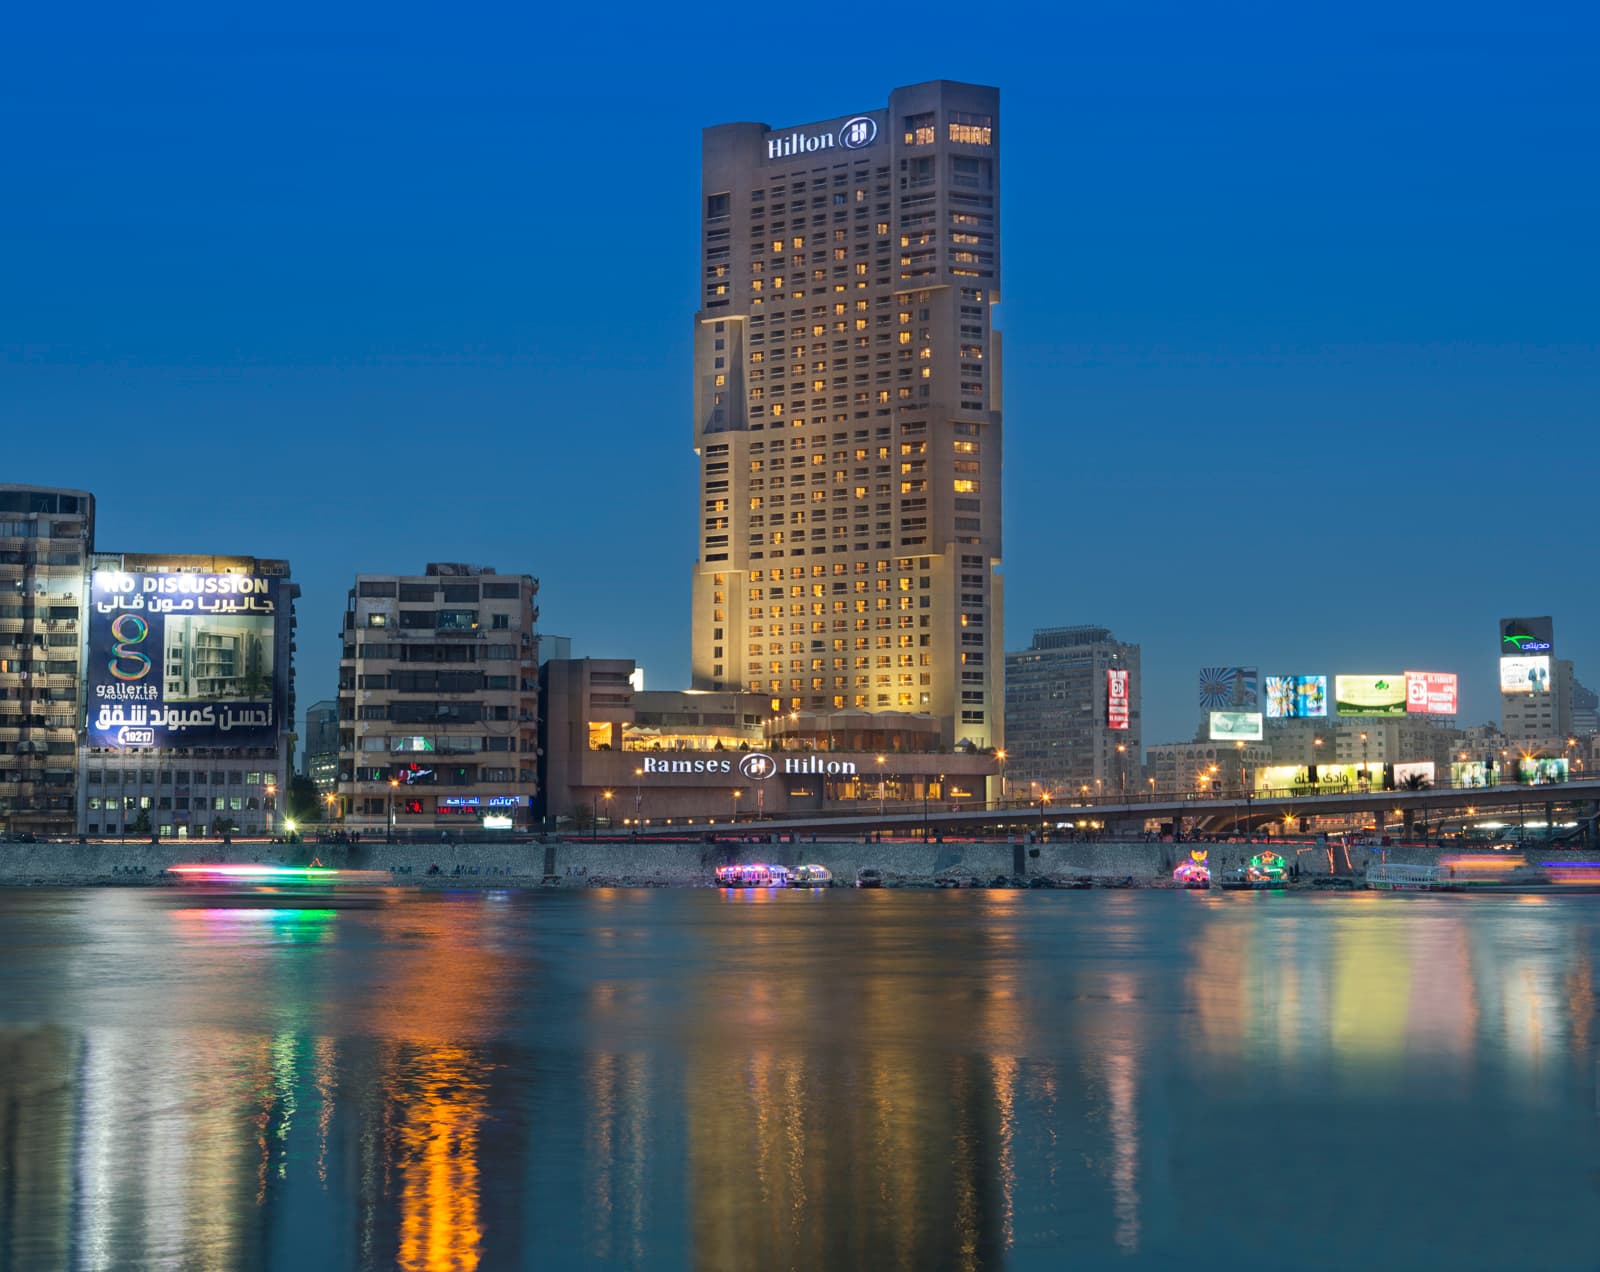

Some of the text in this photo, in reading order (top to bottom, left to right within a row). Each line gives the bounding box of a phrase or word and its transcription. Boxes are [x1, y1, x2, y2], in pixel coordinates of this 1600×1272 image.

[768, 132, 834, 159] Hilton
[103, 577, 269, 594] NO DISCUSSION
[147, 596, 194, 612] مون
[197, 595, 275, 613] جاليريا
[96, 683, 158, 697] galleria
[150, 705, 216, 731] كمبوند
[643, 757, 731, 774] Ramses
[785, 755, 856, 774] Hilton
